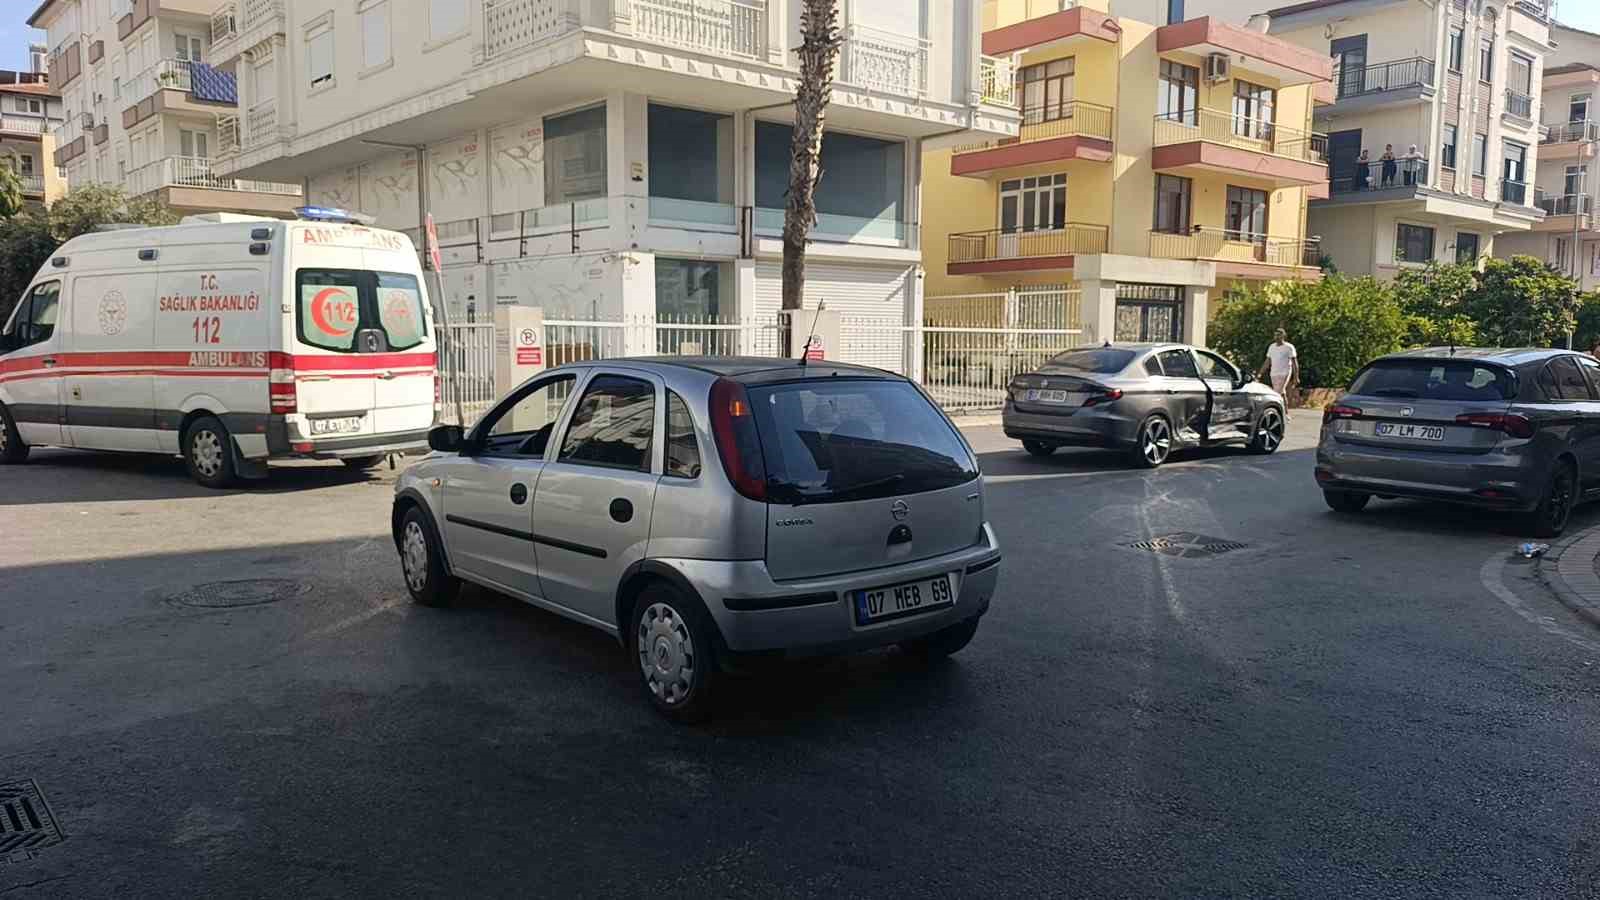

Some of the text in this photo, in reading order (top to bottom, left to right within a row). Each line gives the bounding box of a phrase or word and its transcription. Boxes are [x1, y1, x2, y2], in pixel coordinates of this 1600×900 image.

[304, 228, 402, 249] AMBANS
[200, 274, 219, 291] T.C.
[160, 290, 260, 312] SAĞLIK BAKANLIĞI
[324, 302, 355, 322] 112
[192, 316, 221, 344] 112
[189, 351, 266, 367] AMBULANS
[1381, 424, 1393, 434] 07
[1420, 427, 1442, 438] 700
[868, 592, 884, 615] 07
[931, 580, 948, 602] 69
